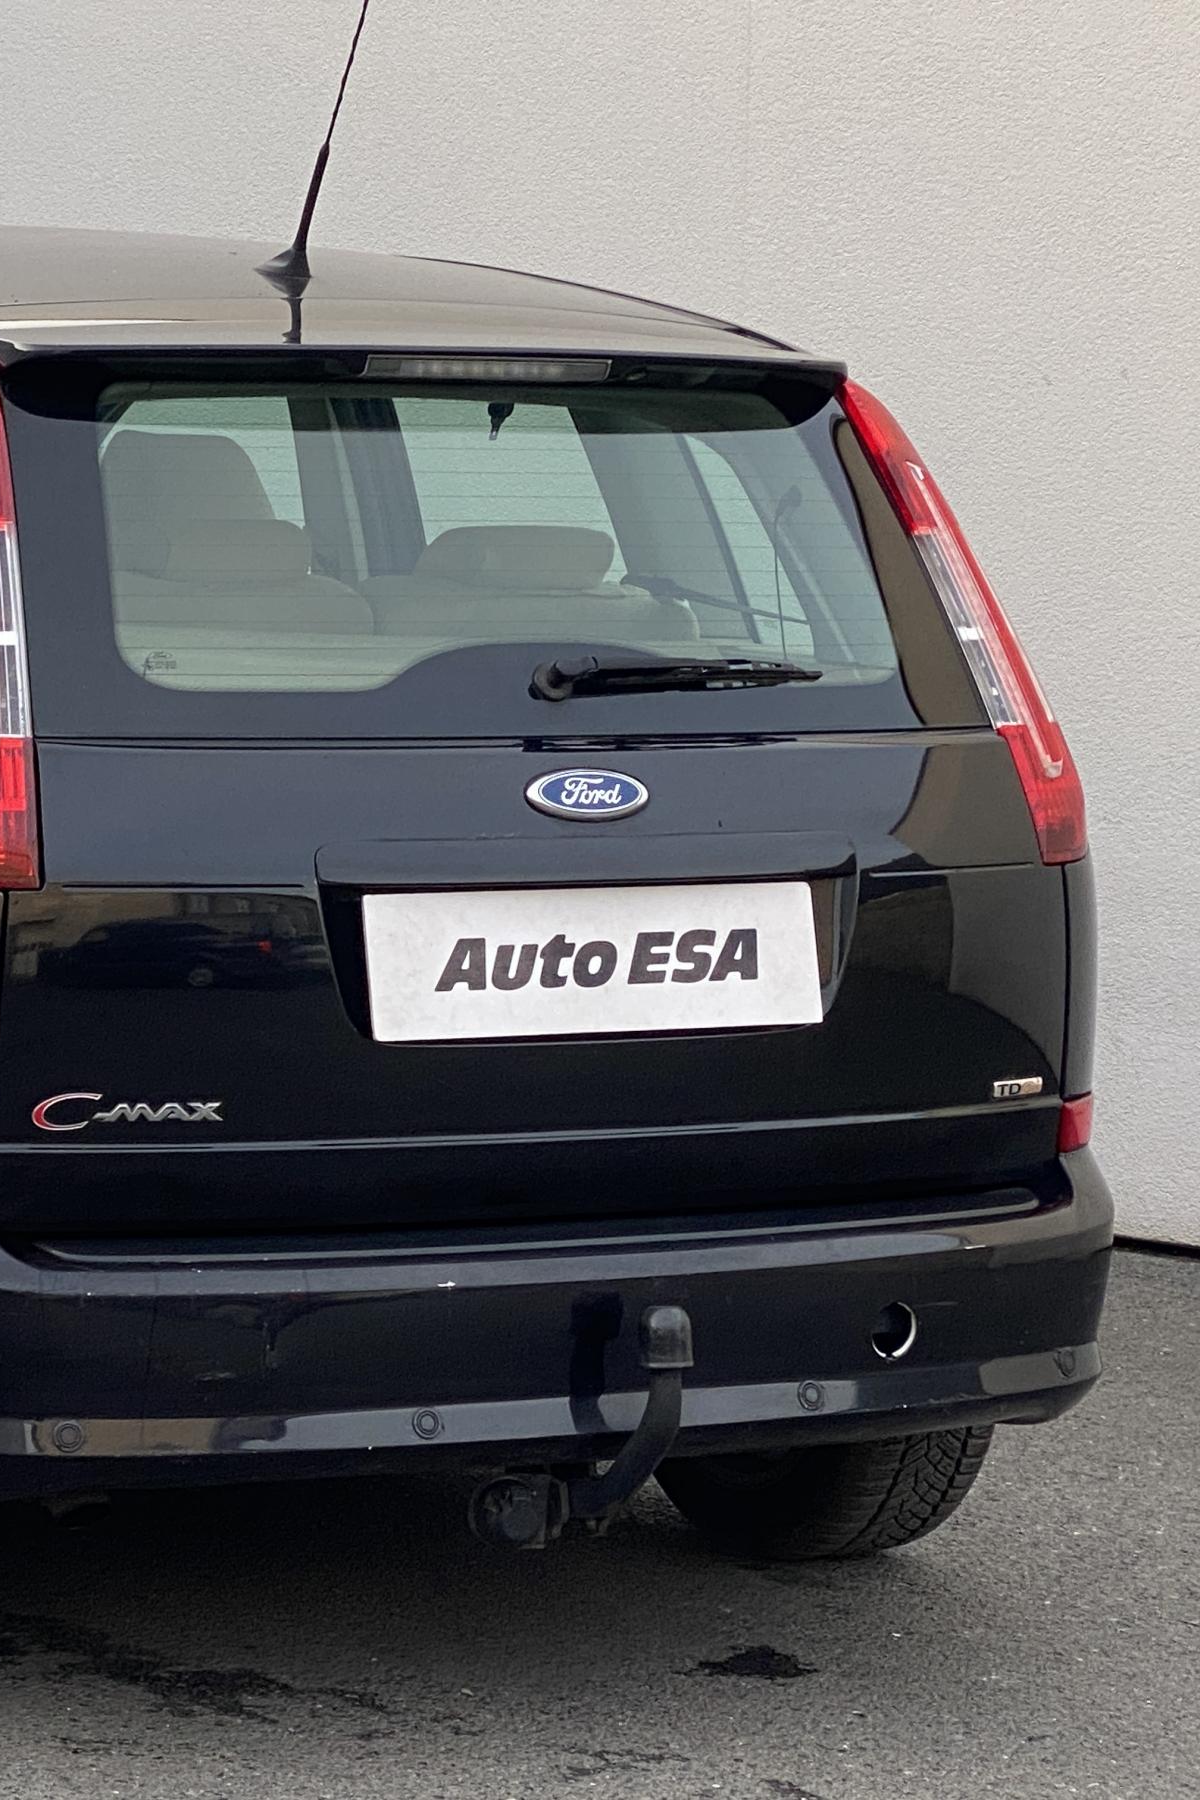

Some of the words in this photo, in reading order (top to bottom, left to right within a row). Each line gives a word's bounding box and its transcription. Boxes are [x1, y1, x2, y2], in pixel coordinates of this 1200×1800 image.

[561, 777, 622, 805] Ford
[434, 934, 618, 992] Auto
[627, 928, 758, 984] ESA
